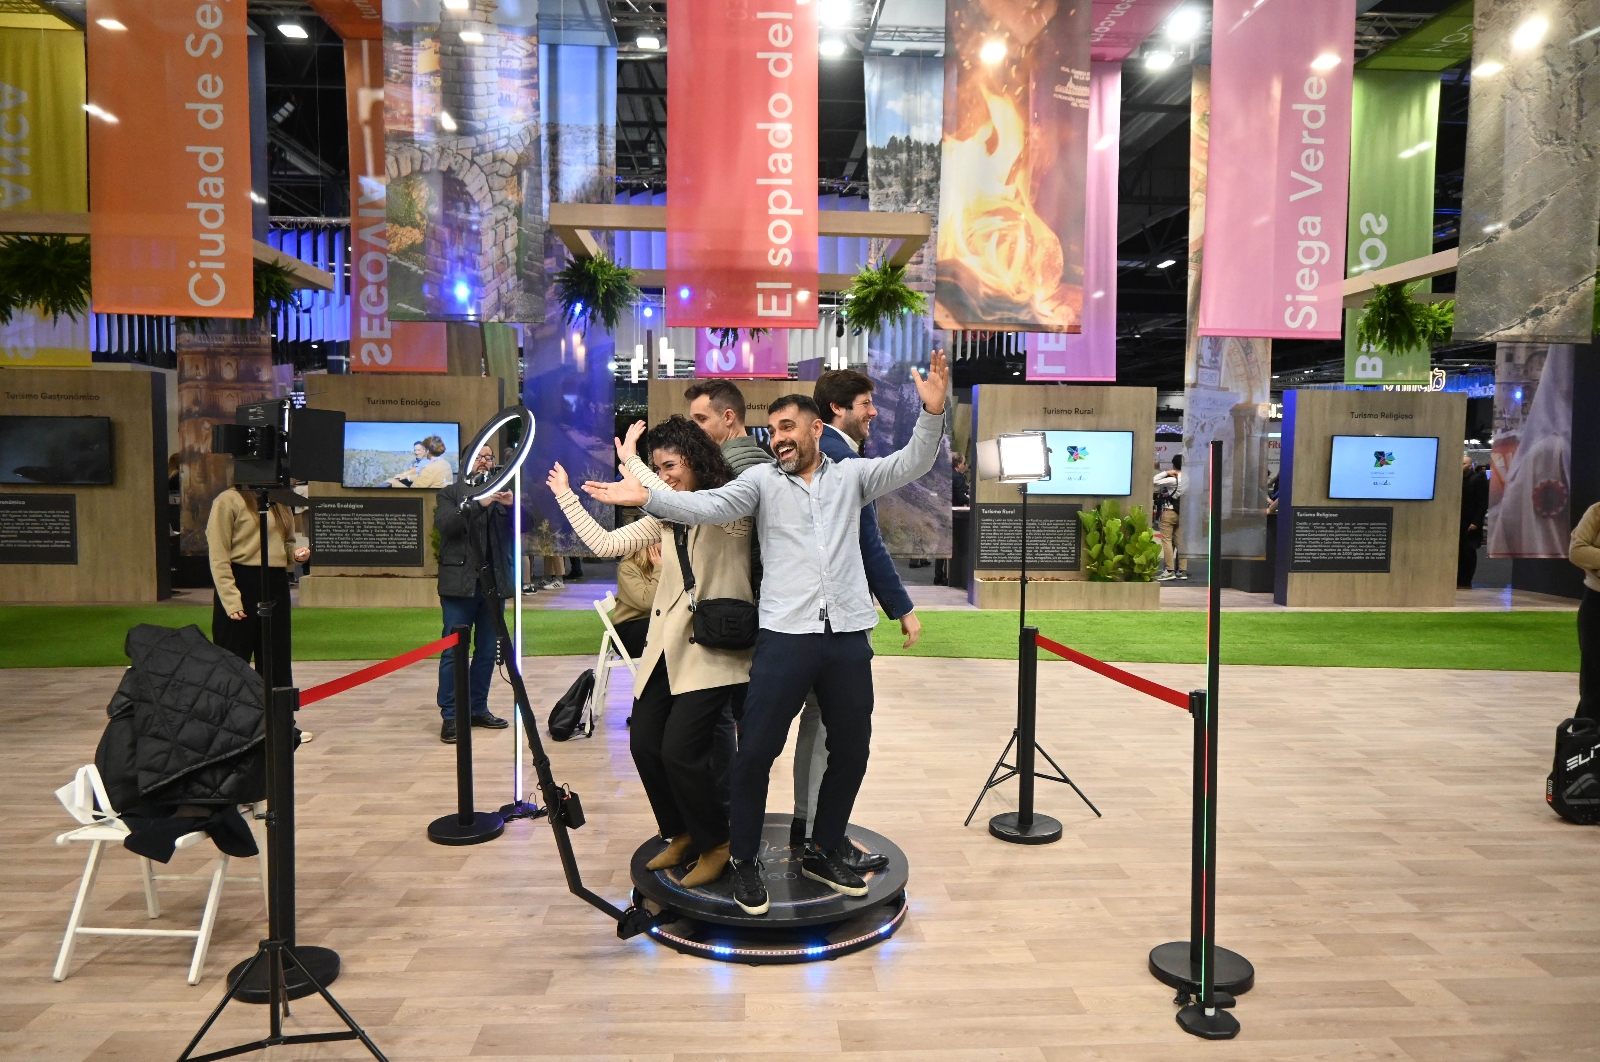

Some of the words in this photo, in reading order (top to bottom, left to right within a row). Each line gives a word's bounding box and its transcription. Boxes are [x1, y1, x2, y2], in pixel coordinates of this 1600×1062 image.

[185, 0, 230, 58] Se
[756, 11, 793, 78] del
[185, 73, 224, 130] de
[1289, 75, 1328, 202] Verde
[756, 92, 804, 268] soplado
[185, 145, 226, 306] Ciudad
[757, 281, 793, 317] El
[1285, 215, 1331, 330] Siega
[5, 392, 38, 400] Turismo
[41, 392, 100, 401] Gastronómico
[366, 397, 398, 405] Turismo
[401, 398, 441, 408] Enológico
[746, 402, 772, 410] dustri
[1043, 407, 1072, 415] Turismo
[1074, 407, 1094, 415] Rural
[1350, 411, 1378, 419] Turismo
[1380, 412, 1414, 420] Religioso
